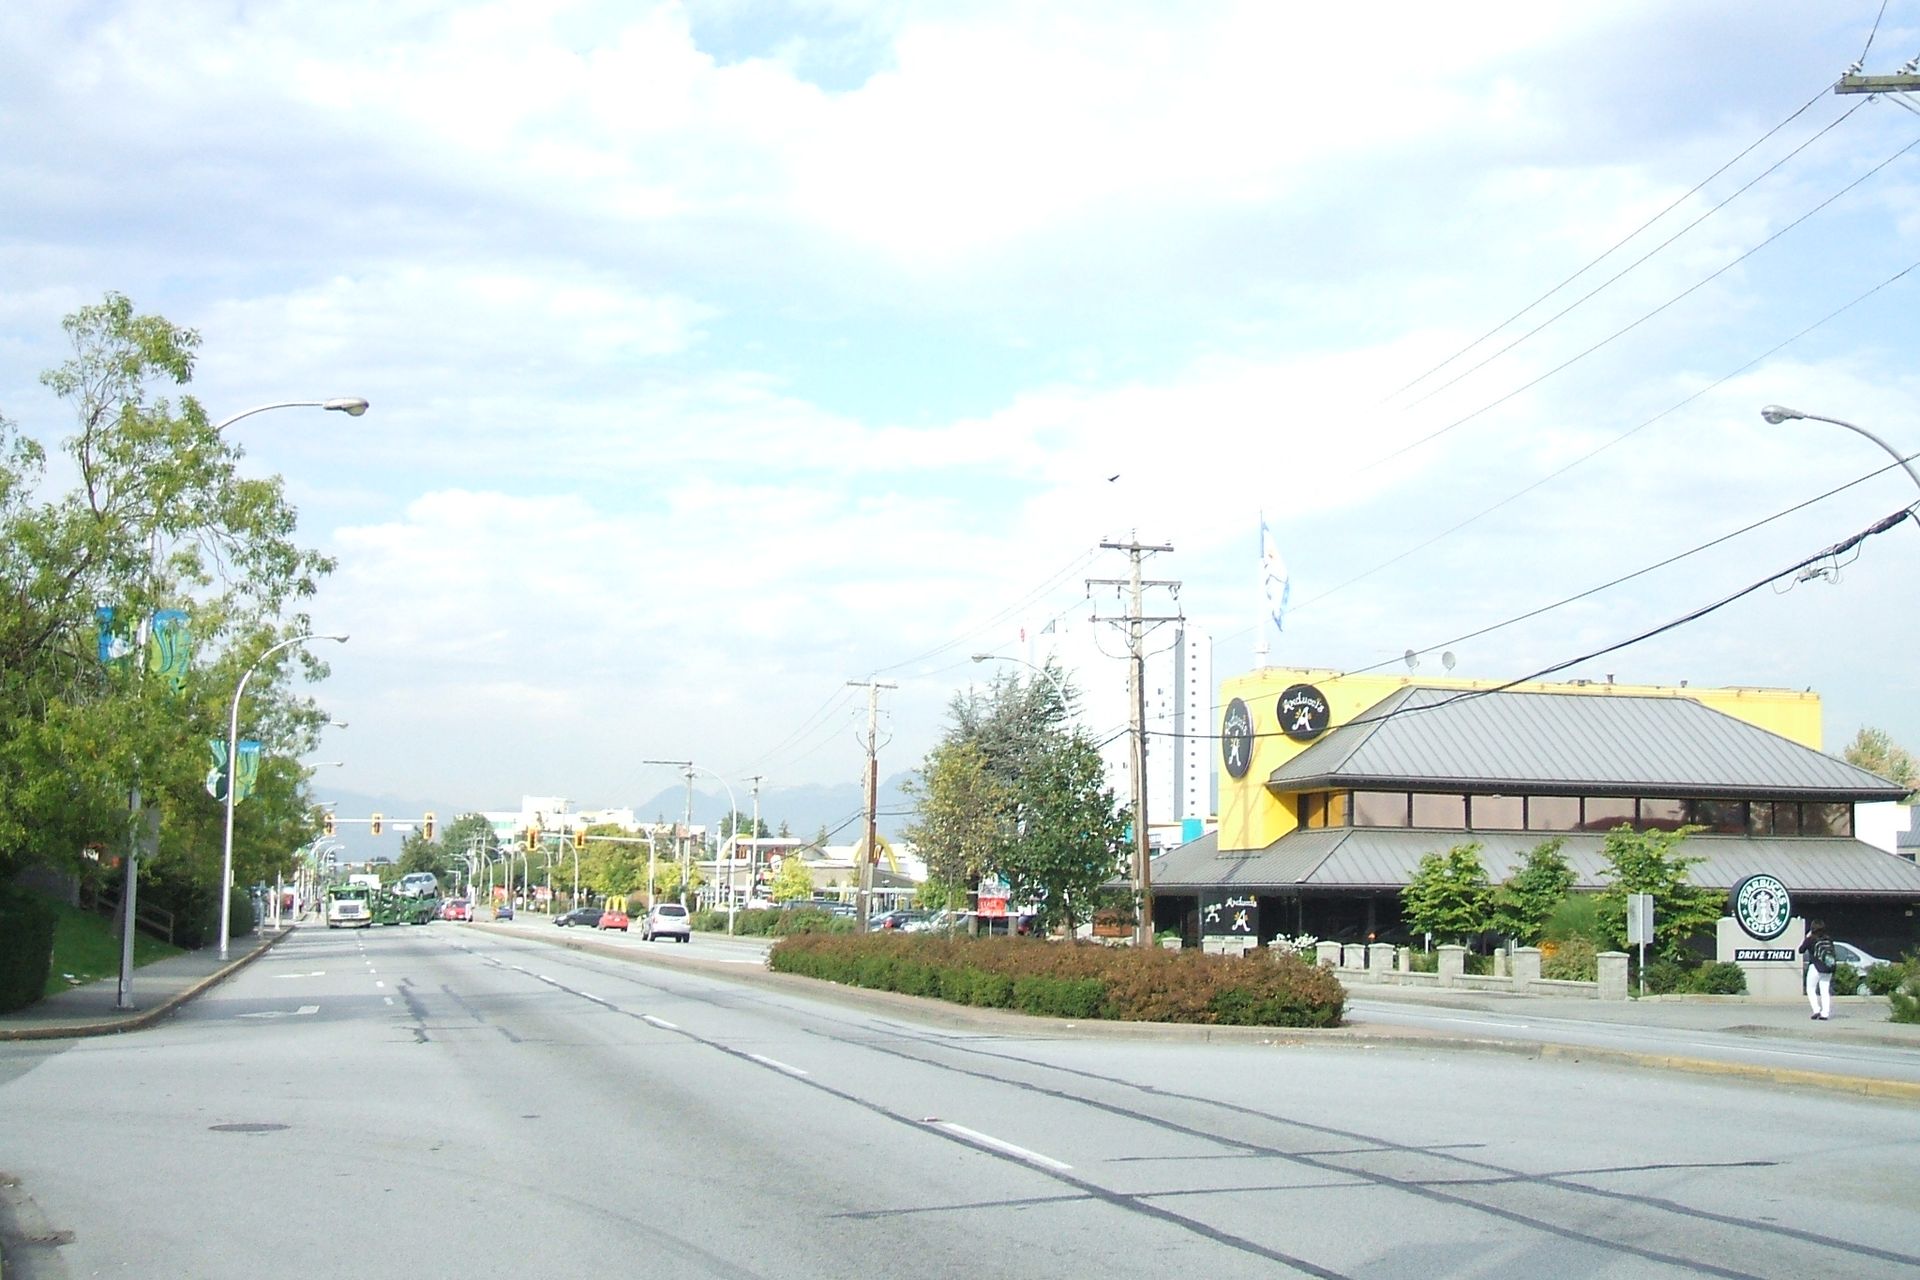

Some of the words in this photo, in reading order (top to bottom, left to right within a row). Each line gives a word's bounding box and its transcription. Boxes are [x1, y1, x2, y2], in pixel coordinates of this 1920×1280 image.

[1740, 879, 1787, 906] STARBUCKS
[1745, 916, 1782, 933] COFFEE
[1738, 951, 1765, 960] DRIVE
[1767, 951, 1792, 960] THRU
